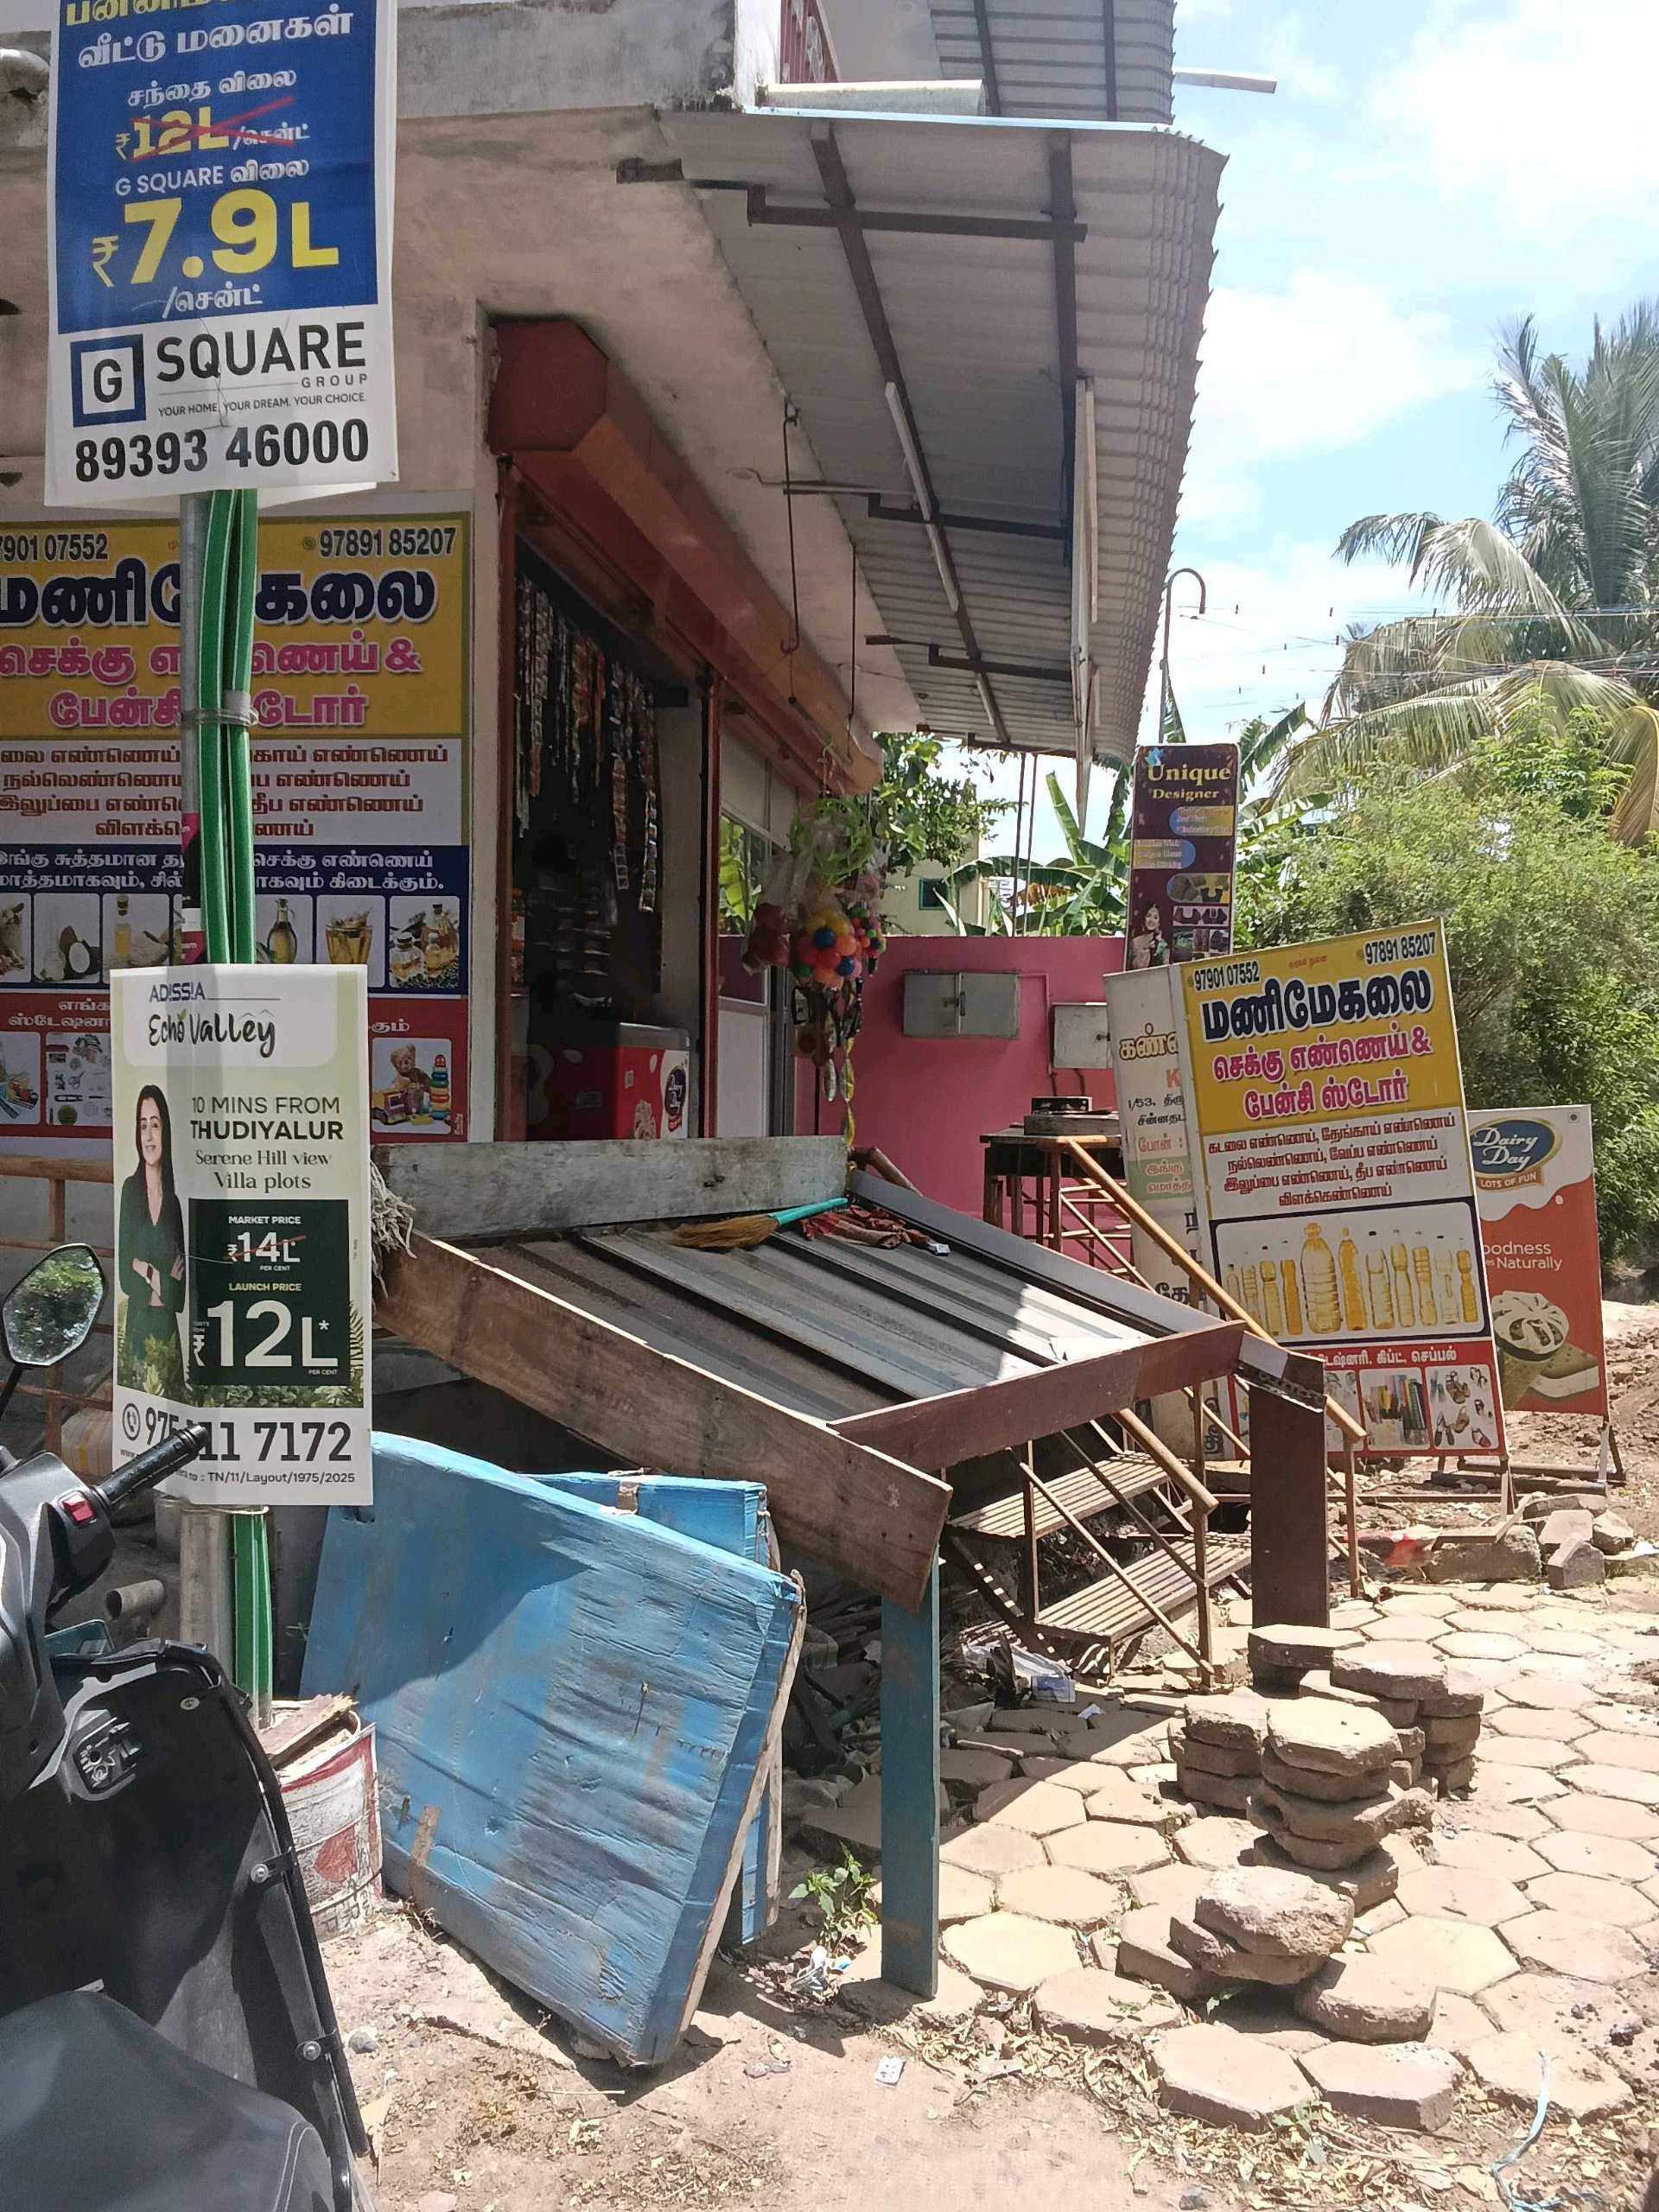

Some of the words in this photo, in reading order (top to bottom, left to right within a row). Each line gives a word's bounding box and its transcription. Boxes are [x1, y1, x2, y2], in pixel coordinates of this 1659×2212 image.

[79, 31, 166, 68] வீட்டு
[177, 3, 353, 54] மனைகள்
[128, 79, 211, 109] சந்தை
[219, 69, 296, 94] விலை
[116, 177, 131, 196] G
[137, 165, 224, 194] SQUARE
[231, 159, 309, 183] விலை
[93, 359, 123, 403] G
[156, 321, 366, 383] SQUARE
[302, 373, 368, 389] GROUP
[158, 405, 187, 417] YOUR
[222, 400, 251, 412] YOUR
[294, 394, 323, 407] YOUR
[75, 429, 207, 483] 89393
[226, 418, 369, 468] 46000
[0, 535, 38, 561] 901
[45, 533, 108, 561] 07552
[320, 529, 384, 557] 97891
[389, 527, 457, 556] 85207
[385, 637, 422, 674] &
[313, 744, 448, 762] எண்ணெய்
[276, 769, 410, 787] எண்ணெய்
[1147, 764, 1231, 785] Unique
[289, 794, 423, 811] எண்ணெய்
[1152, 788, 1220, 802] Designer
[321, 849, 433, 868] எண்ணெய்
[1364, 940, 1398, 965] 97891
[1401, 931, 1436, 958] 85207
[1194, 965, 1225, 991] 97901
[1227, 961, 1260, 986] 07552
[1203, 969, 1433, 1041] மணிமேகலை
[148, 1013, 185, 1047] Echo
[189, 1012, 276, 1058] Valley
[1213, 1045, 1285, 1082] செக்கு
[1290, 1022, 1409, 1071] எண்ணெய்
[1411, 1025, 1431, 1055] &
[192, 1097, 206, 1114] 10
[212, 1096, 268, 1114] MINS
[276, 1096, 340, 1114] FROM
[1245, 1082, 1314, 1120] பேன்சி
[1322, 1068, 1408, 1109] ஸ்டோர்
[190, 1120, 344, 1141] THUDIYALUR
[1473, 1127, 1539, 1153] Dairy
[195, 1150, 252, 1165] Serene
[257, 1150, 287, 1165] Hill
[293, 1153, 331, 1165] view
[1208, 1142, 1247, 1154] கடலை
[1482, 1145, 1531, 1172] Day
[214, 1172, 257, 1189] Villa
[264, 1173, 311, 1193] plots
[1480, 1179, 1502, 1188] LOTS
[1504, 1178, 1516, 1187] OF
[1518, 1172, 1537, 1184] FUN
[228, 1216, 268, 1225] MARKET
[271, 1216, 302, 1225] PRICE
[1483, 1242, 1552, 1255] oodness
[1497, 1257, 1563, 1272] Naturally
[229, 1282, 270, 1292] LAUNCH
[273, 1282, 302, 1292] PRICE
[254, 1421, 352, 1462] 7172
[208, 1471, 355, 1486] TN/11/Layout/1975/2025
